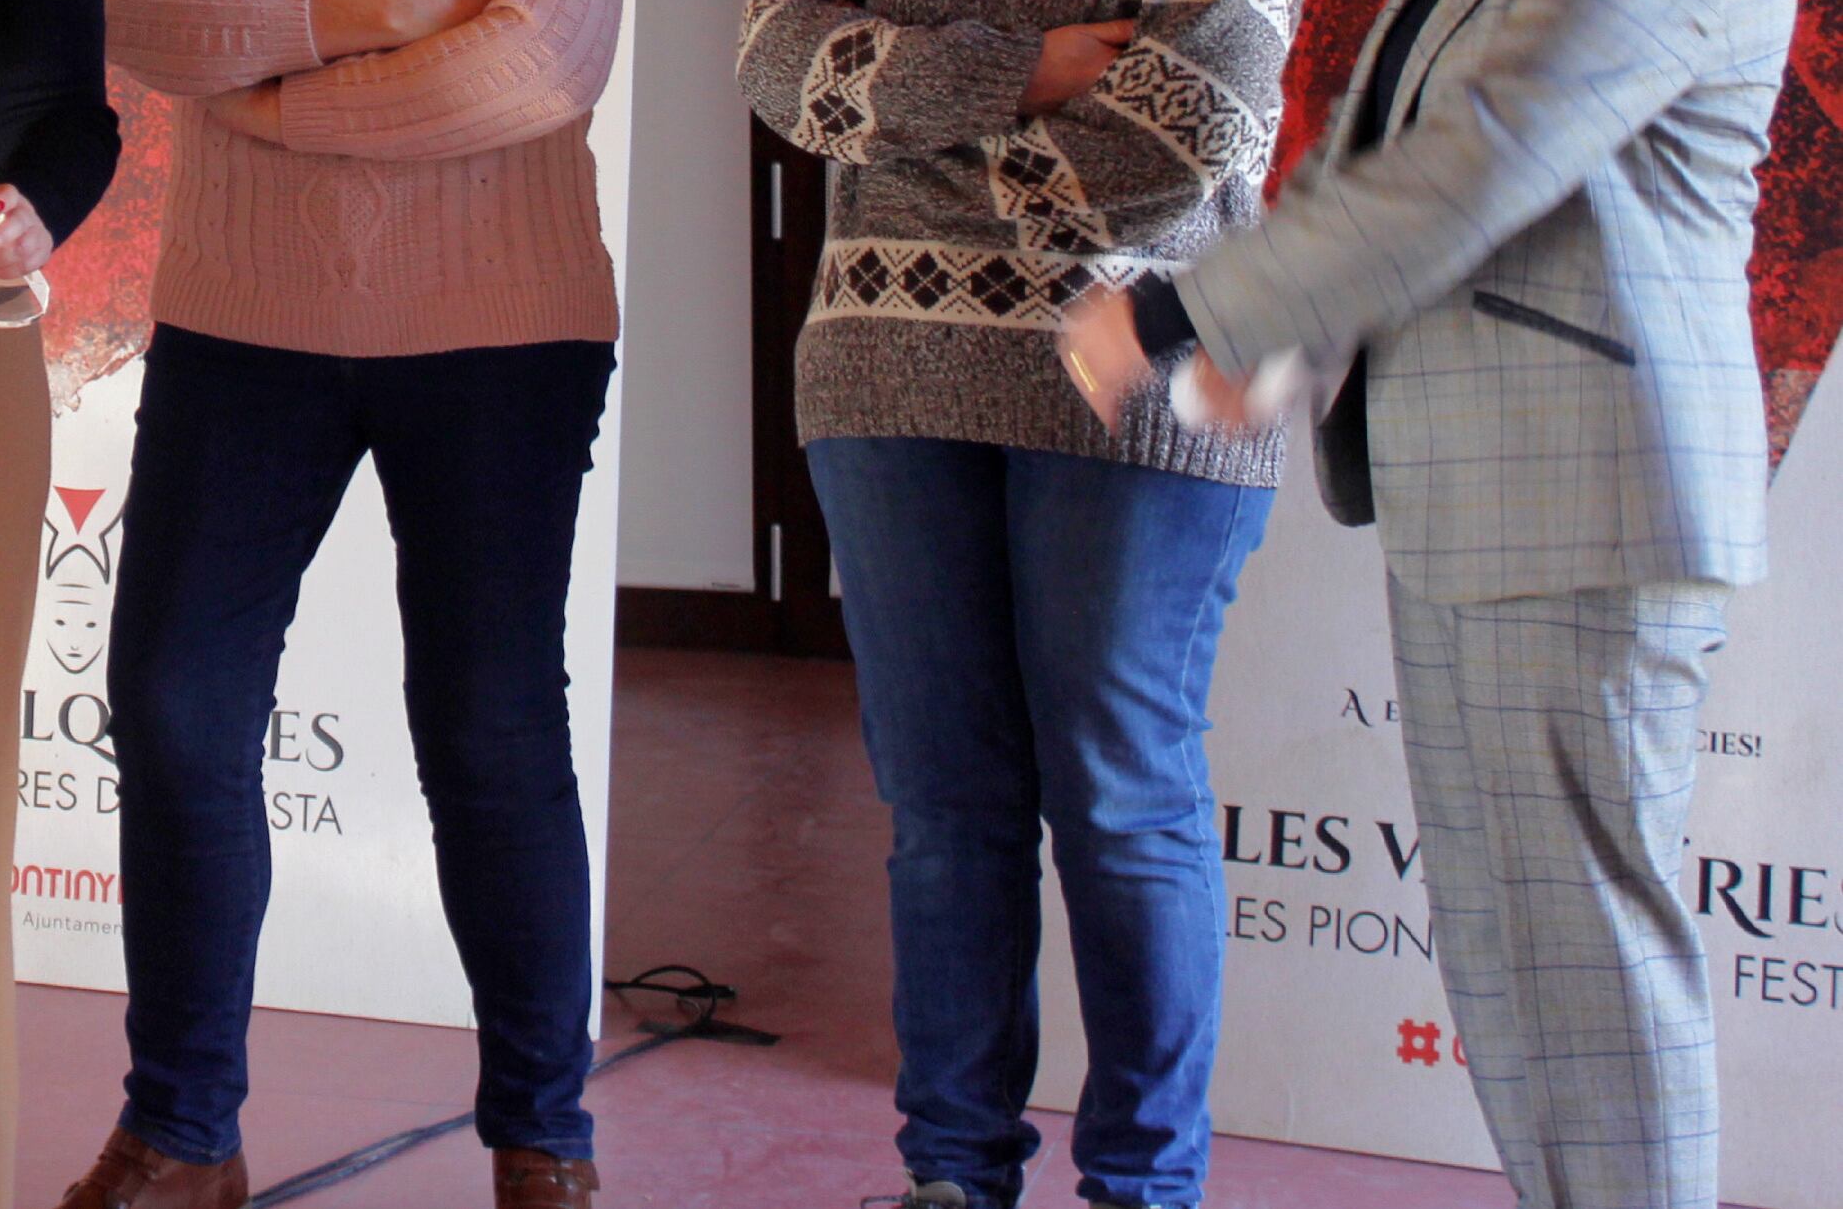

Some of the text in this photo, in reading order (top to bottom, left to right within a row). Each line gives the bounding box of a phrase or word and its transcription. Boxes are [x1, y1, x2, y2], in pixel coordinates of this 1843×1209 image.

[1341, 688, 1373, 728] A
[1221, 804, 1351, 874] LES
[12, 864, 124, 905] NTINY
[1225, 895, 1287, 942] ES
